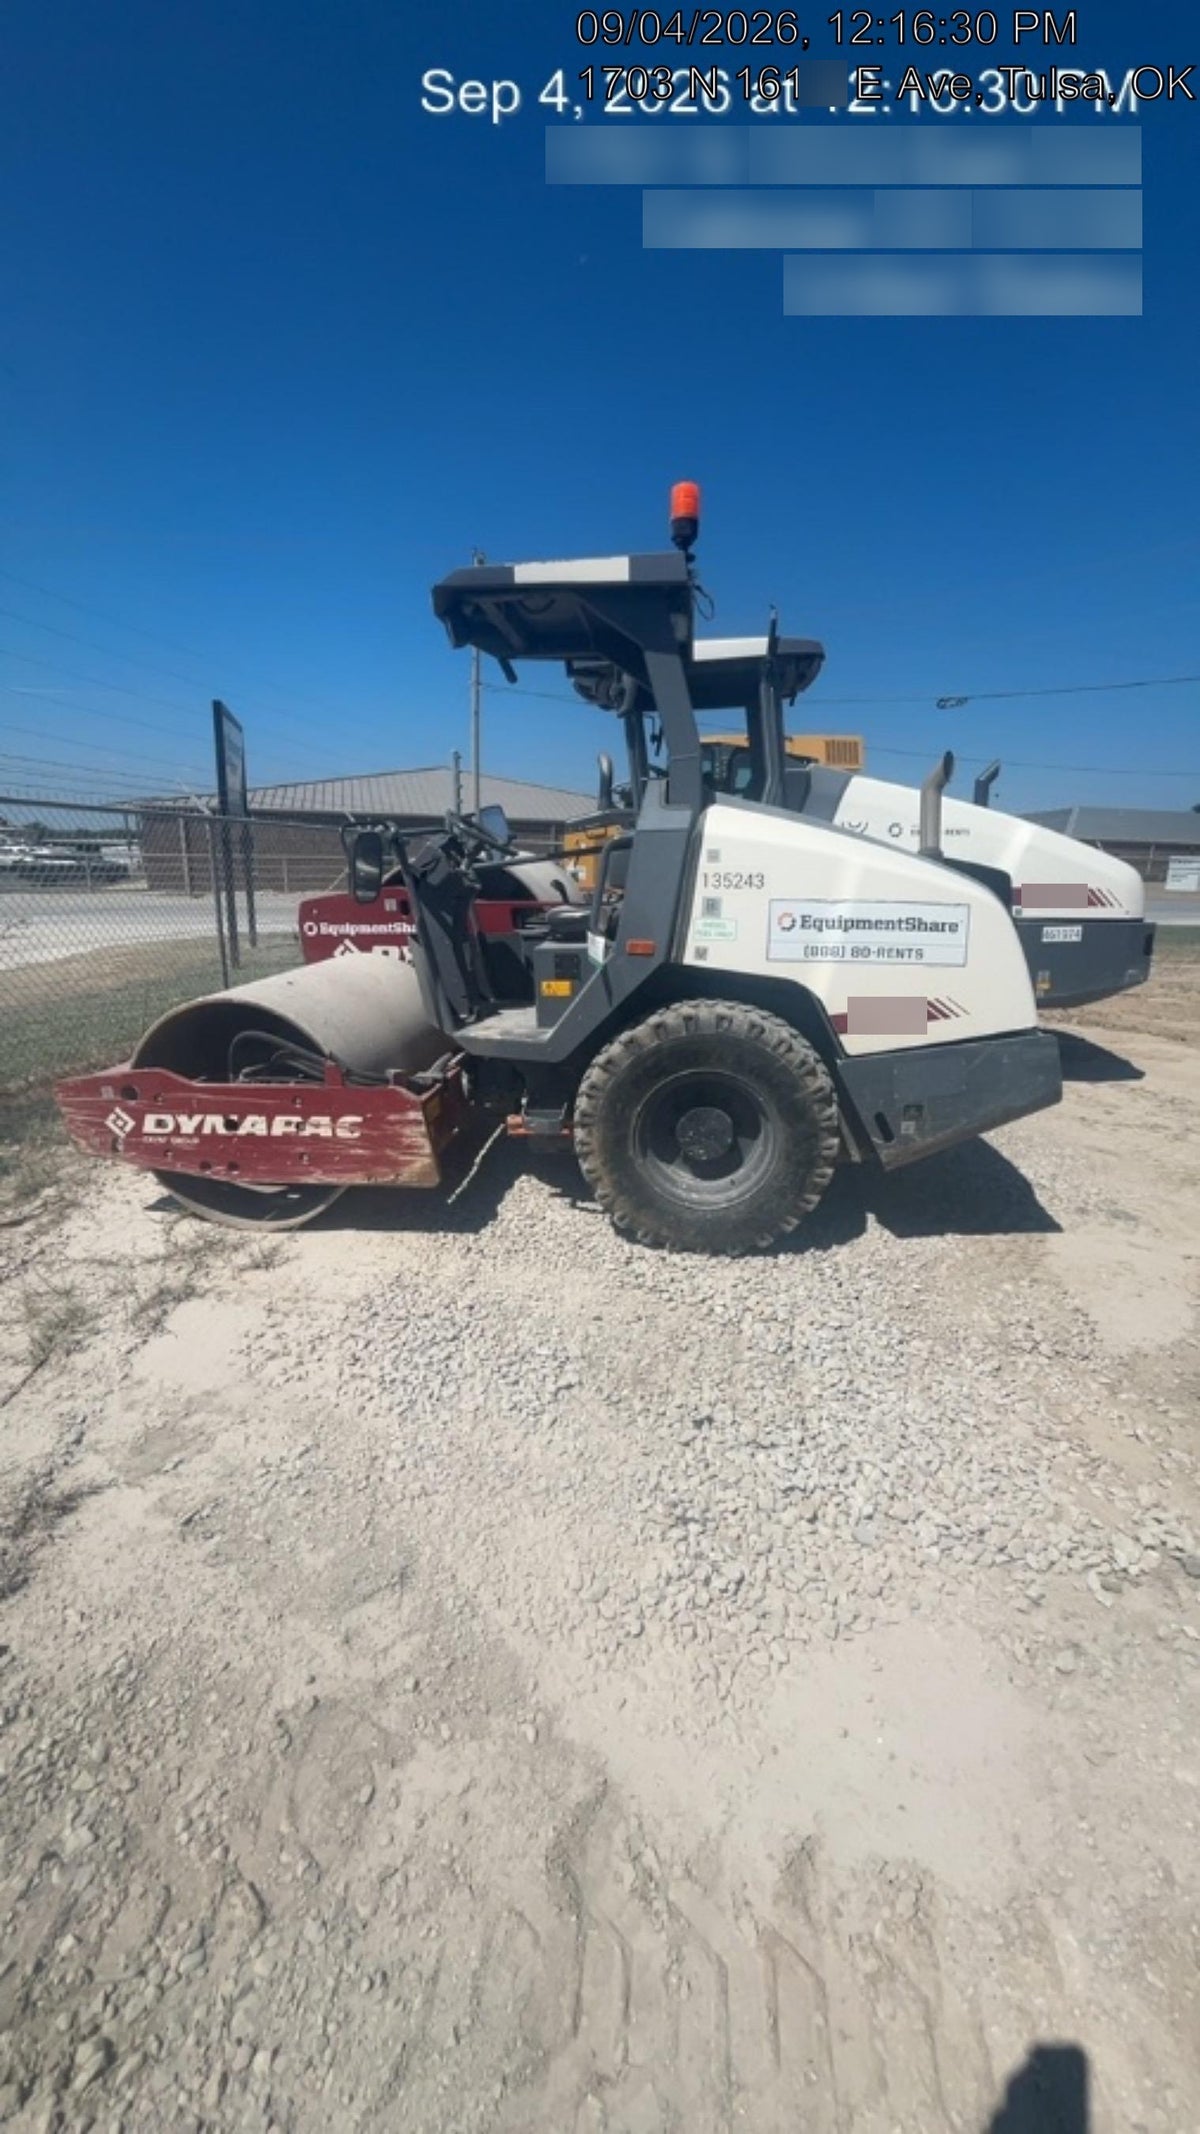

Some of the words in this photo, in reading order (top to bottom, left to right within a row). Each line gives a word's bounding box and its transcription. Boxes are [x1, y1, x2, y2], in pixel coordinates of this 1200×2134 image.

[703, 872, 765, 890] 135243
[319, 921, 418, 937] EquipmentSha
[799, 914, 960, 933] EquipmentShare
[142, 1113, 364, 1138] DYNAPAC
